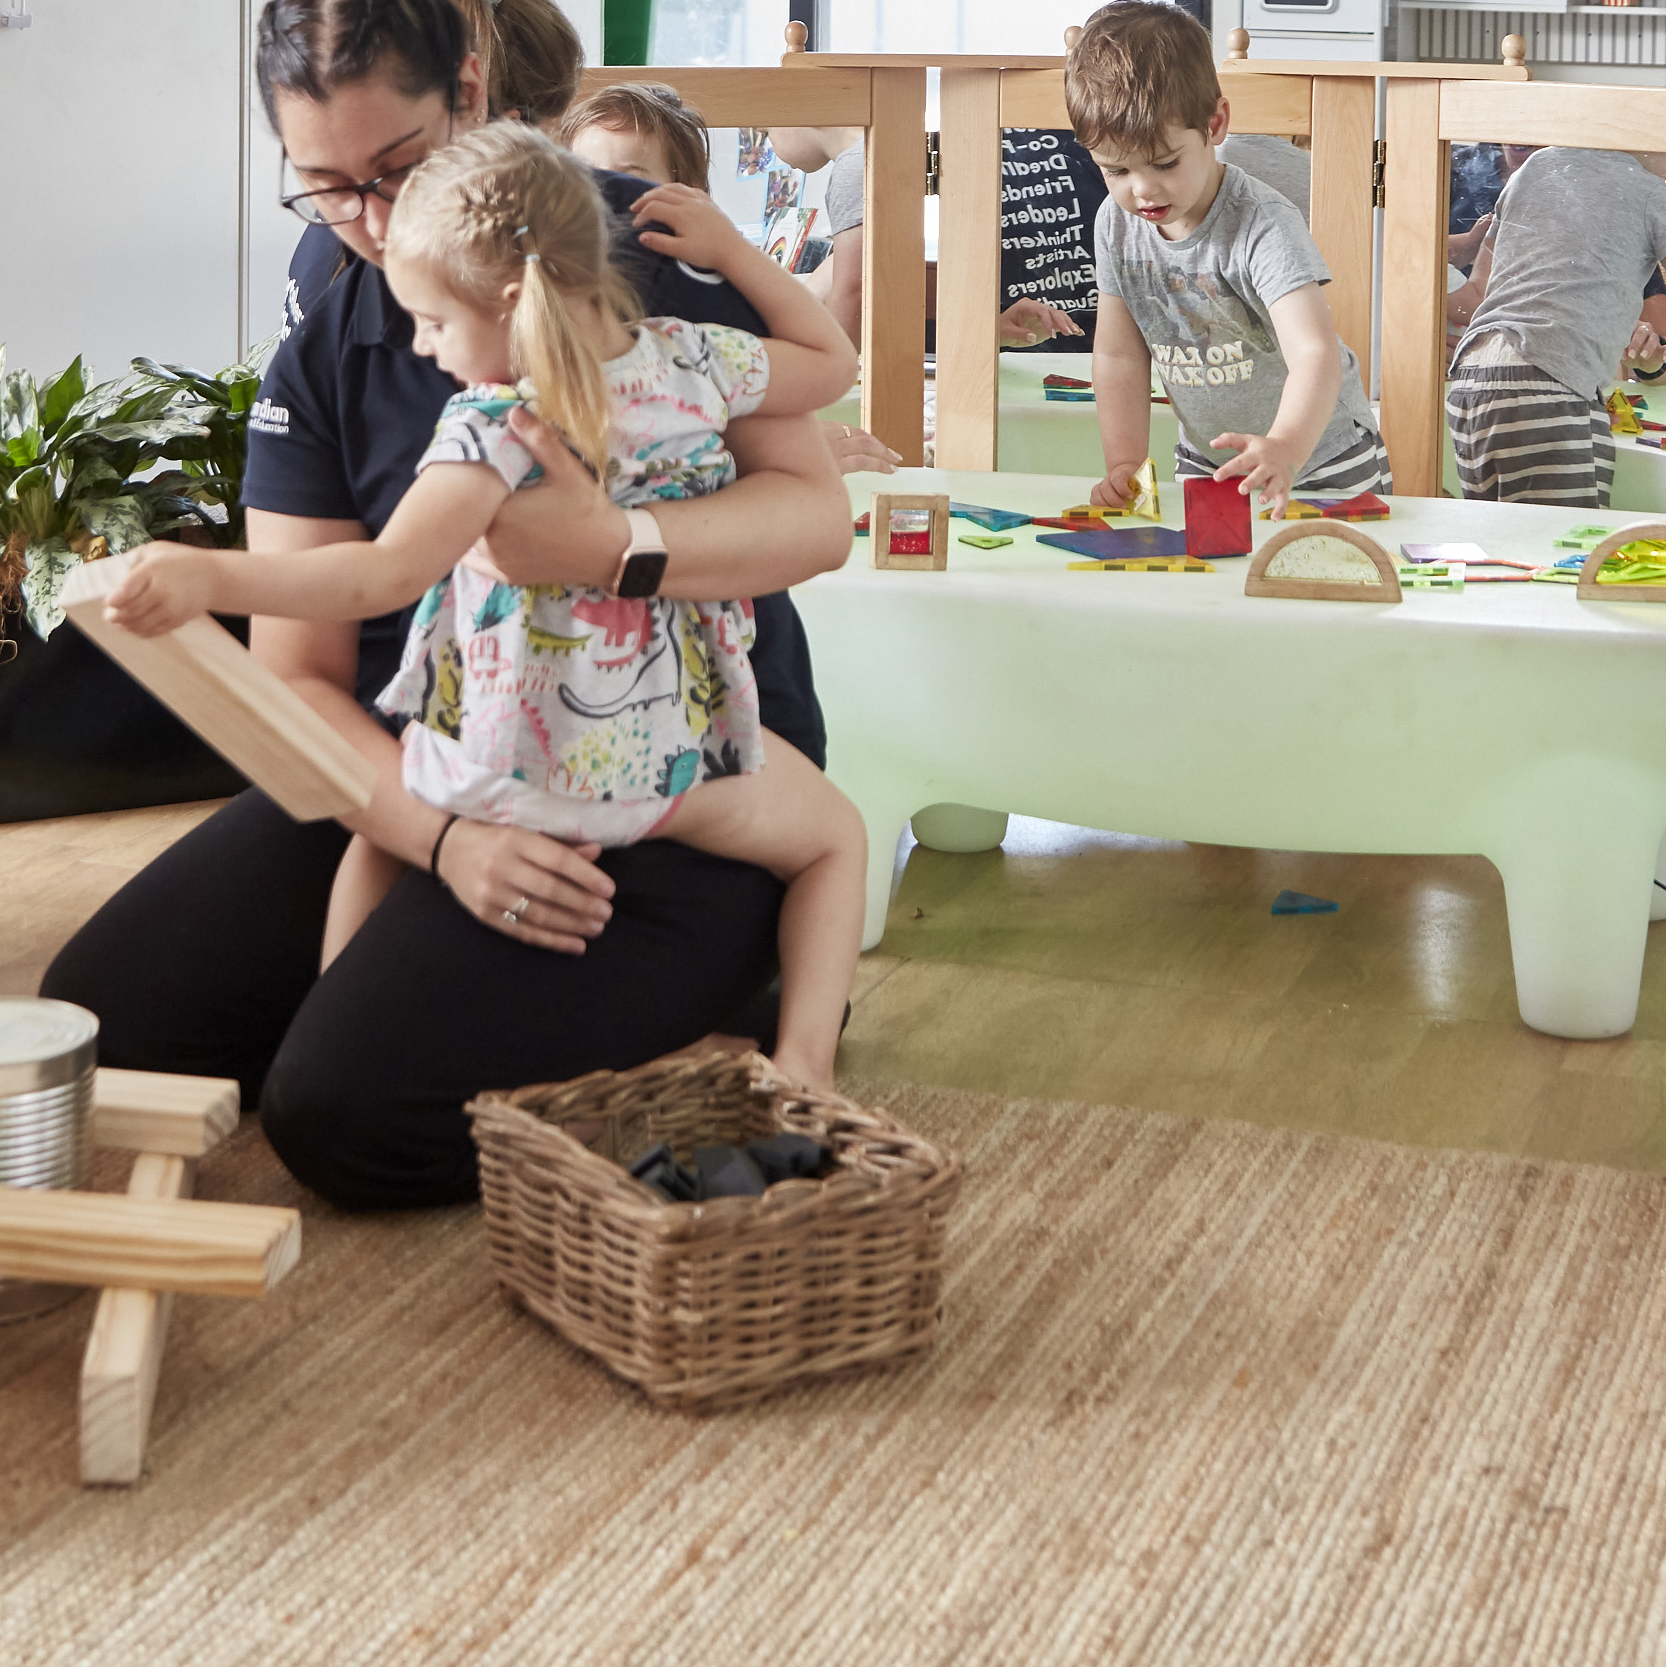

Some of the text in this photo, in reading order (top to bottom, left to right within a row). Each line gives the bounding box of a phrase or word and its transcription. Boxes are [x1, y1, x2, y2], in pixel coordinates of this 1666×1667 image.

[1151, 340, 1244, 366] WAX ON
[1155, 359, 1254, 387] WAX OFF
